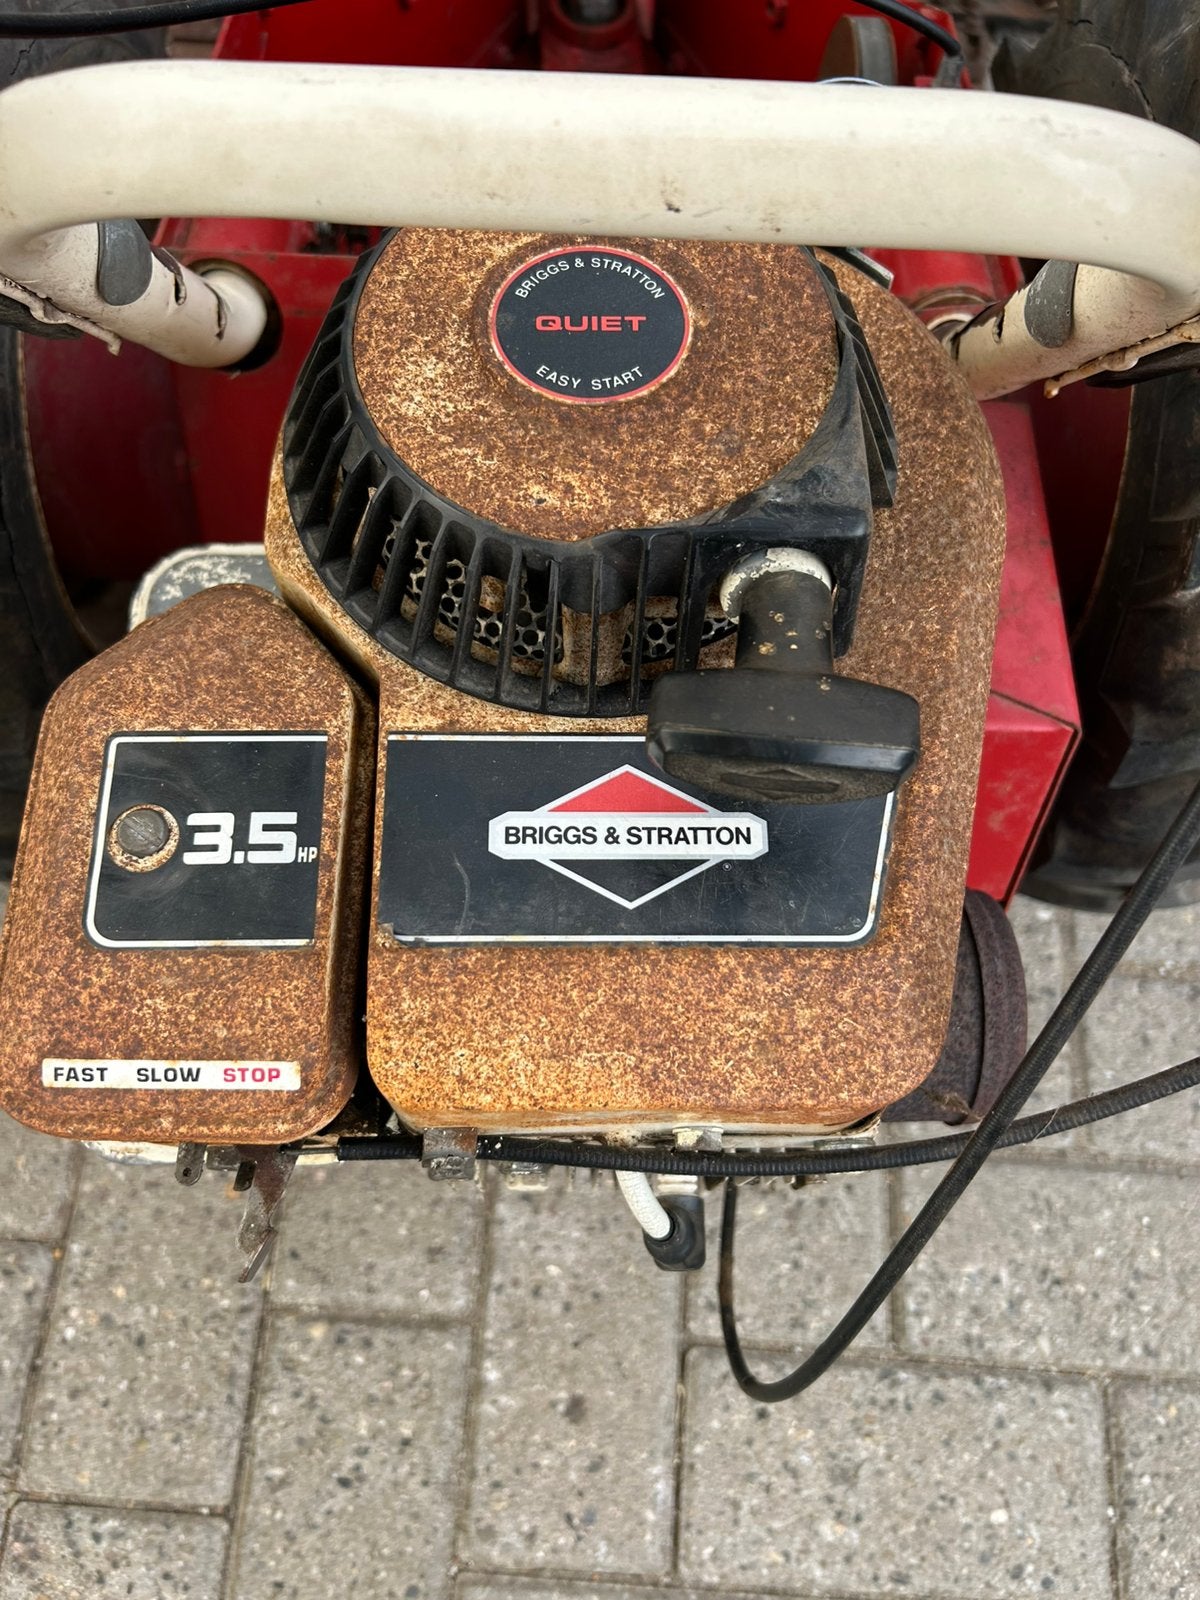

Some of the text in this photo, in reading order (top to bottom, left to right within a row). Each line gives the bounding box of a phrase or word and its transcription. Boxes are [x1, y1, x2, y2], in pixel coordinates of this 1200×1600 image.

[515, 257, 666, 299] BRIGGS & STRATTON
[535, 315, 647, 332] QUIET
[536, 365, 643, 390] EASY START
[504, 825, 752, 845] BRIGGS & STRATTON
[53, 1067, 281, 1083] FAST SLOW STOP
